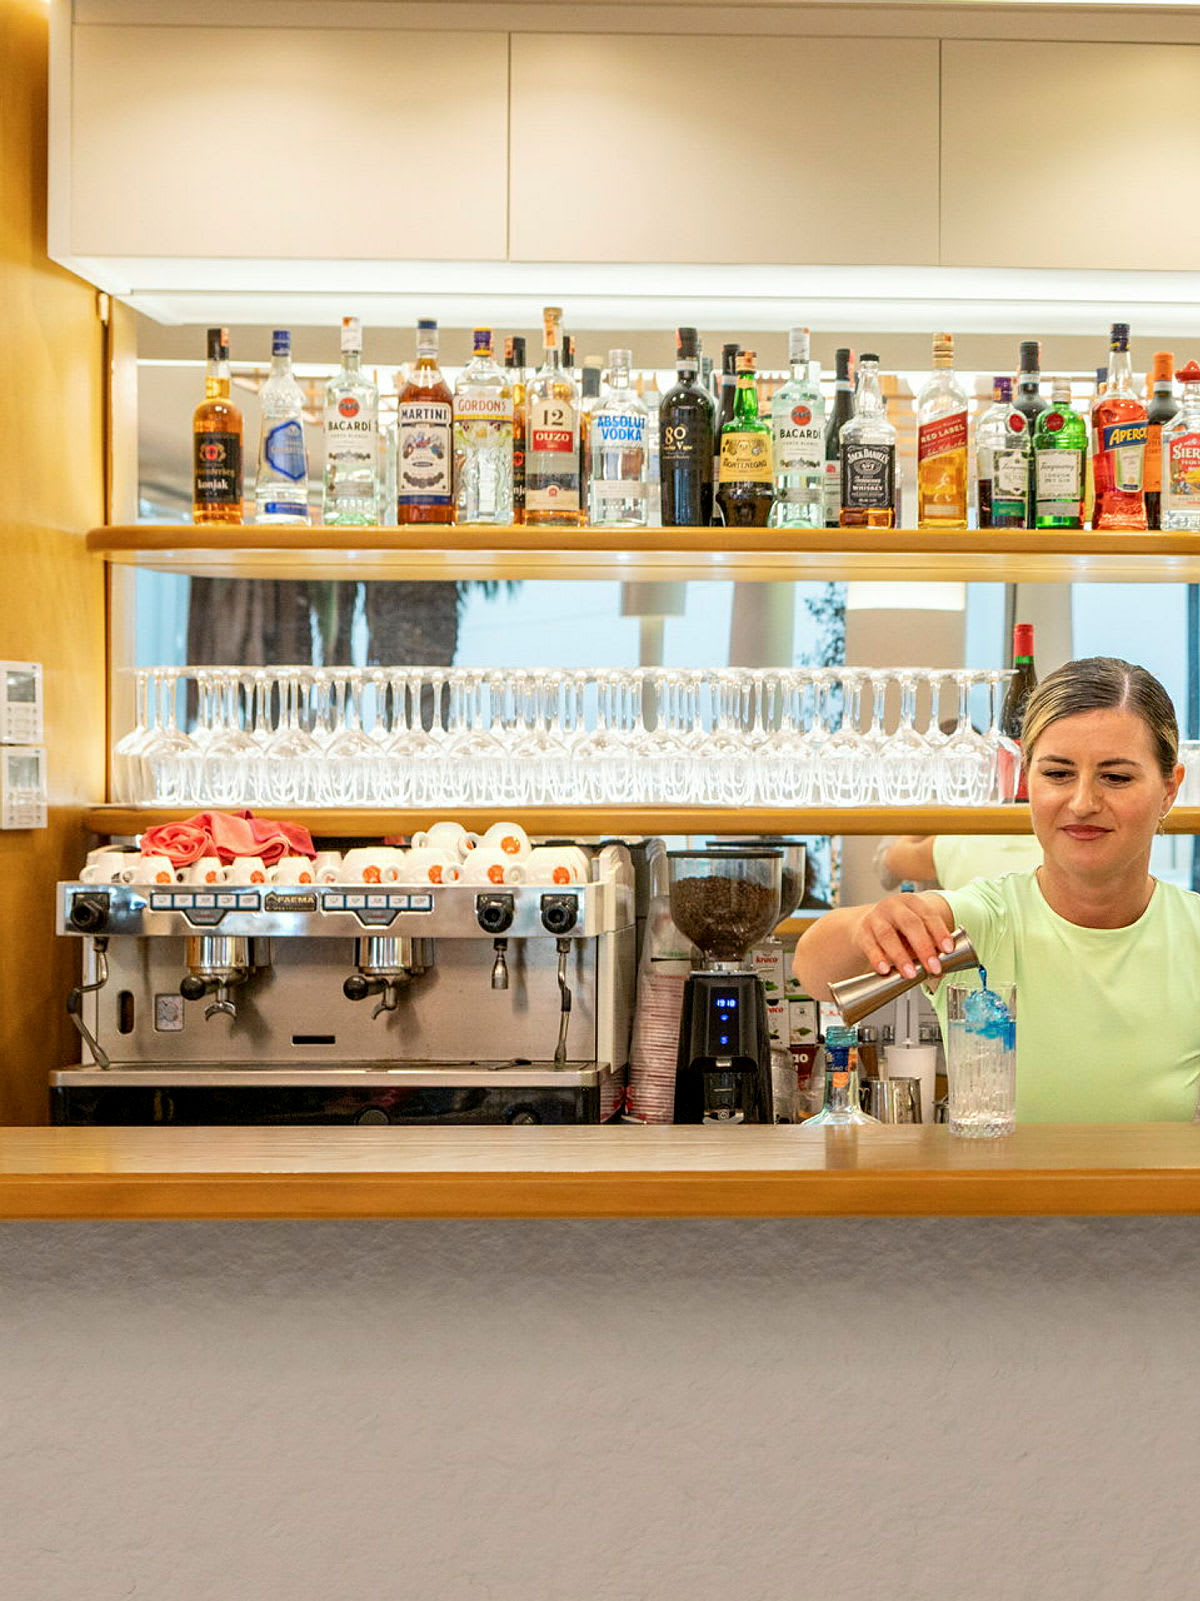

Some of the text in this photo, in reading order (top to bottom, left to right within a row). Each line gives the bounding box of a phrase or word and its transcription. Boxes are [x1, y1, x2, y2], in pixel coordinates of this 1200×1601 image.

[401, 408, 449, 421] MARTINI
[543, 409, 564, 426] 12
[597, 415, 646, 429] ABSOLUT
[535, 431, 570, 442] OUZO
[601, 427, 643, 441] VODKA
[920, 433, 937, 443] RED
[938, 424, 965, 437] LABEL
